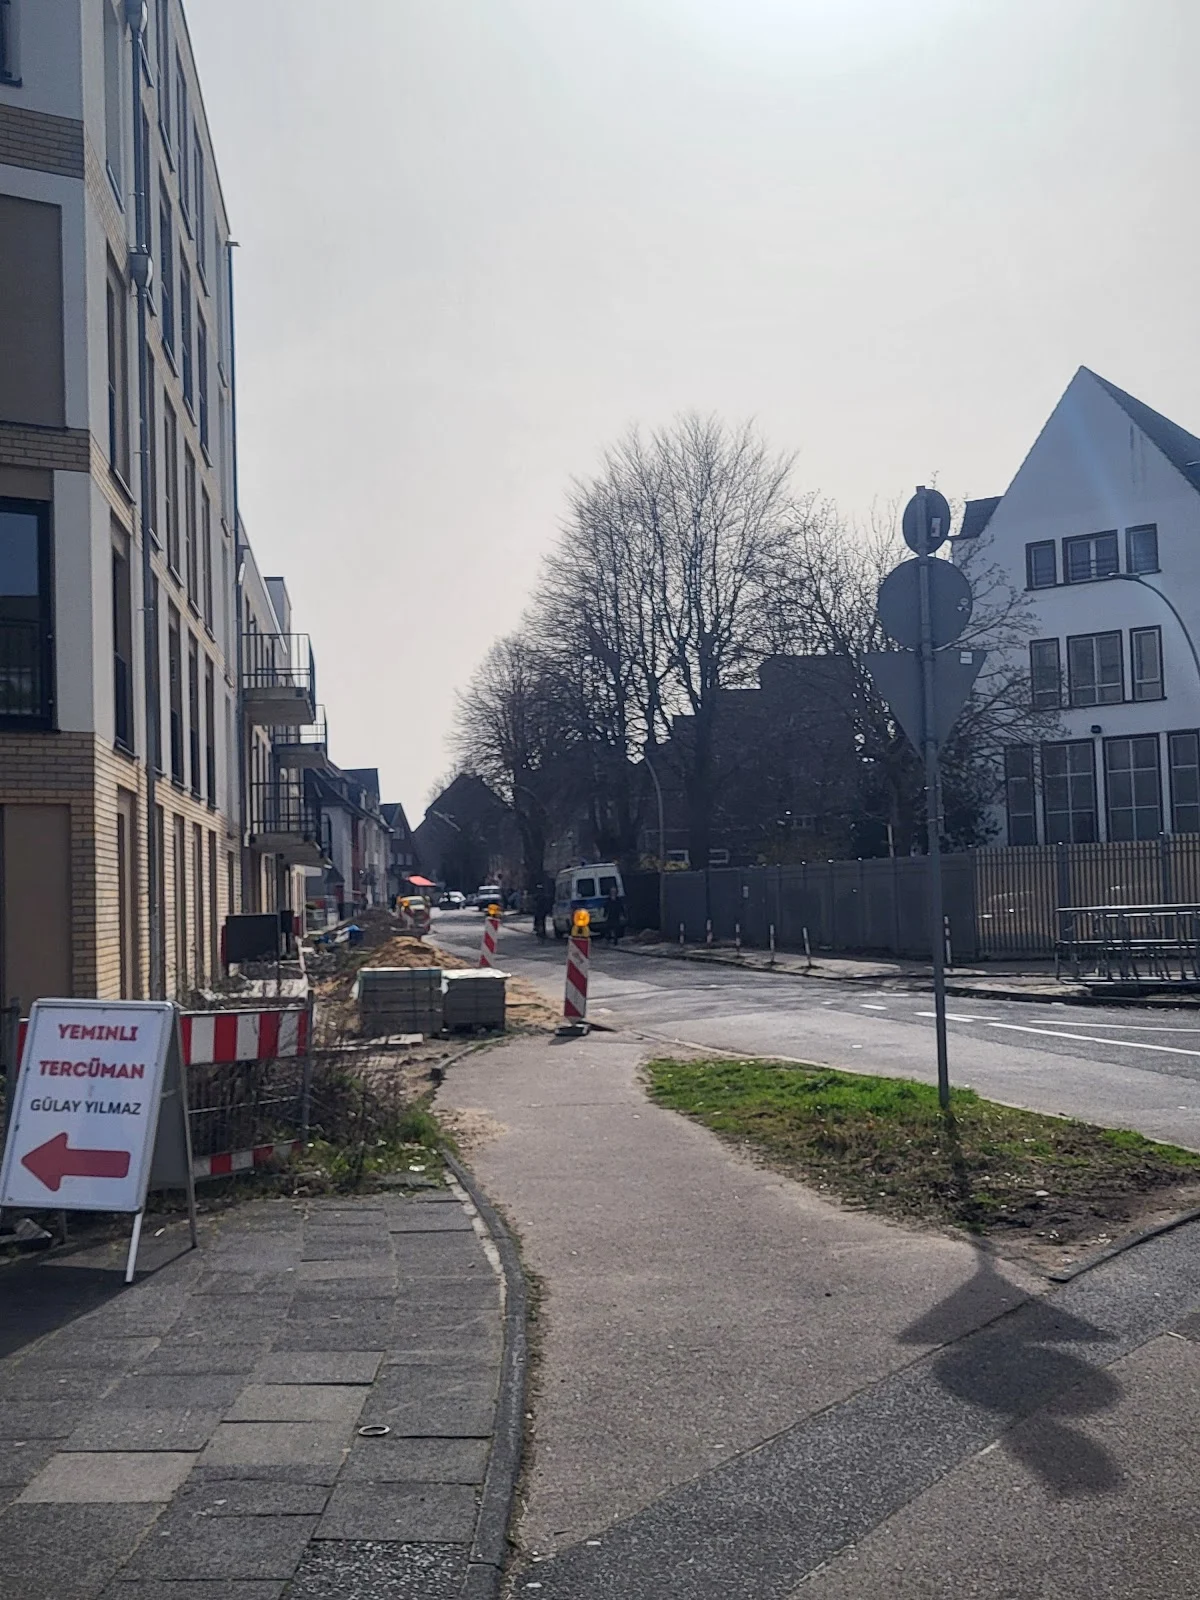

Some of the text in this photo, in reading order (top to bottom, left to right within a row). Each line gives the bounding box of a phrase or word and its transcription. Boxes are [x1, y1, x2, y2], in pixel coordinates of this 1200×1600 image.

[39, 1057, 145, 1079] TERCÜMAN
[30, 1096, 142, 1115] GÜLAY YILMAZ
